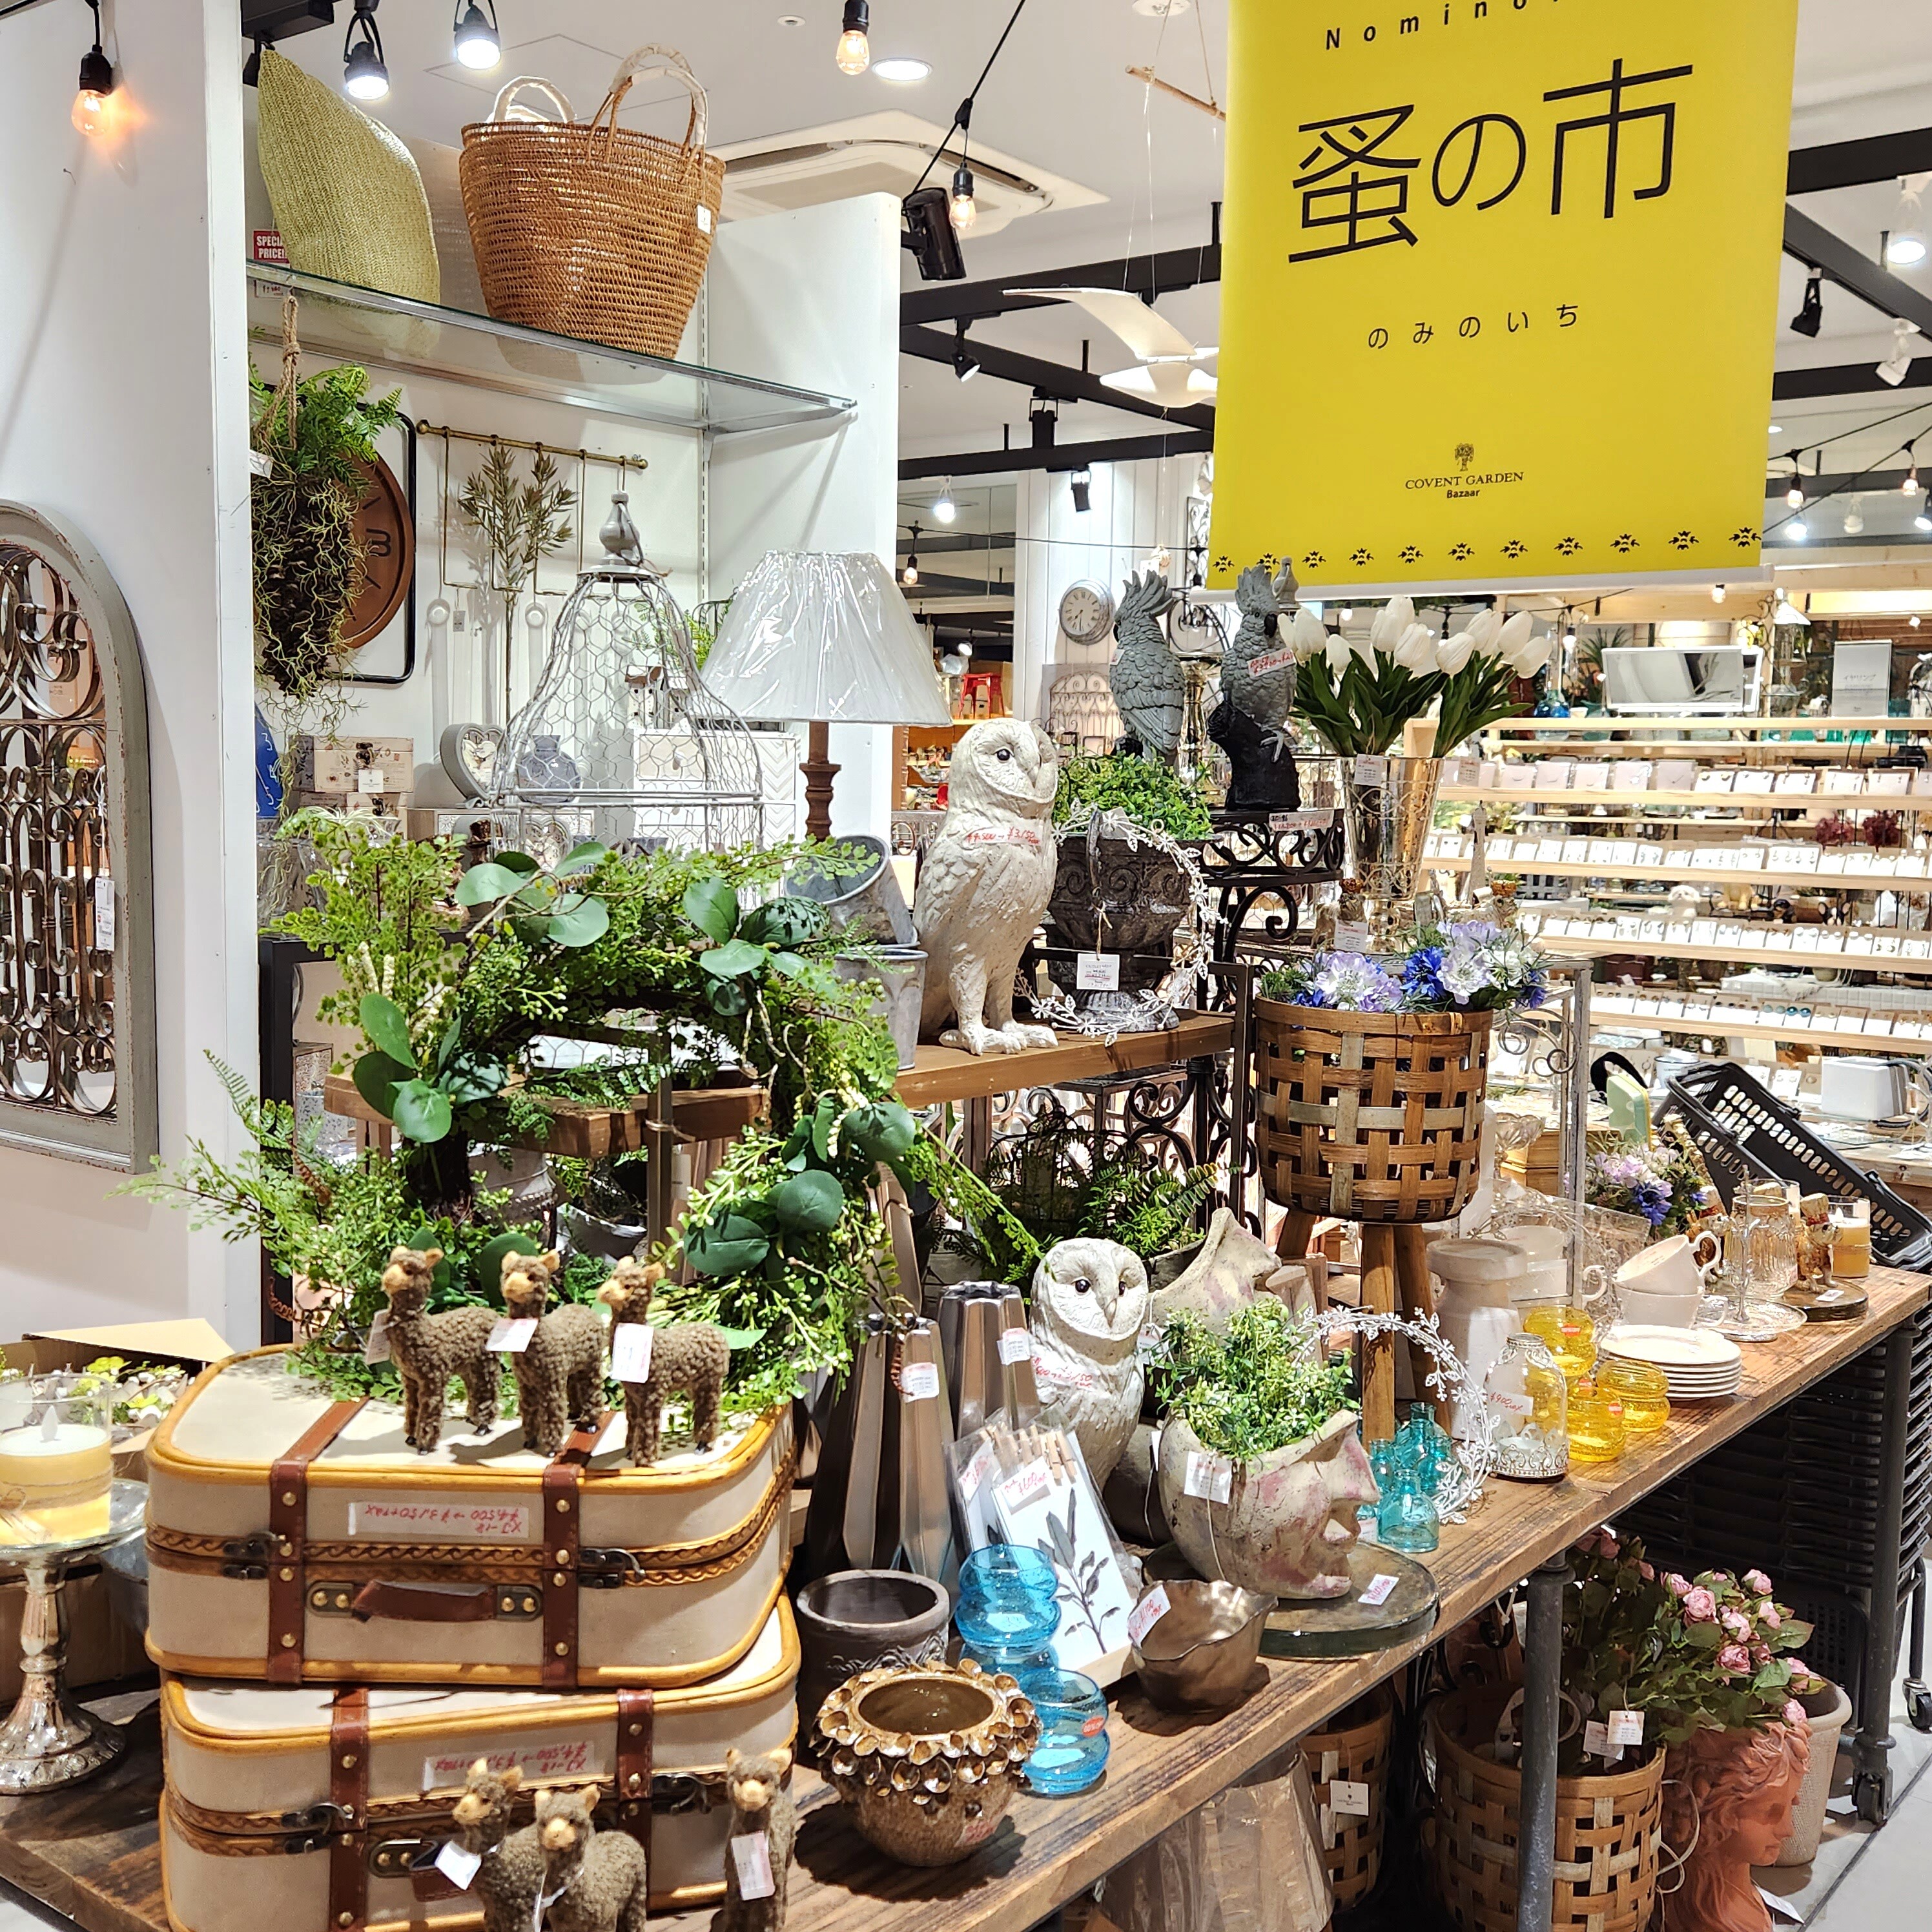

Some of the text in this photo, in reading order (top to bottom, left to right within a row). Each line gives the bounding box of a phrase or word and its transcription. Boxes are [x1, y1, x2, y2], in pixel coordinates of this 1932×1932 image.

[1326, 0, 1558, 50] Nomino
[1289, 58, 1693, 263] 蚤の市
[256, 235, 283, 247] SPECI
[1368, 304, 1579, 349] のみのいち
[1405, 471, 1525, 489] COVENT GARDEN
[1446, 489, 1481, 499] Bazaar
